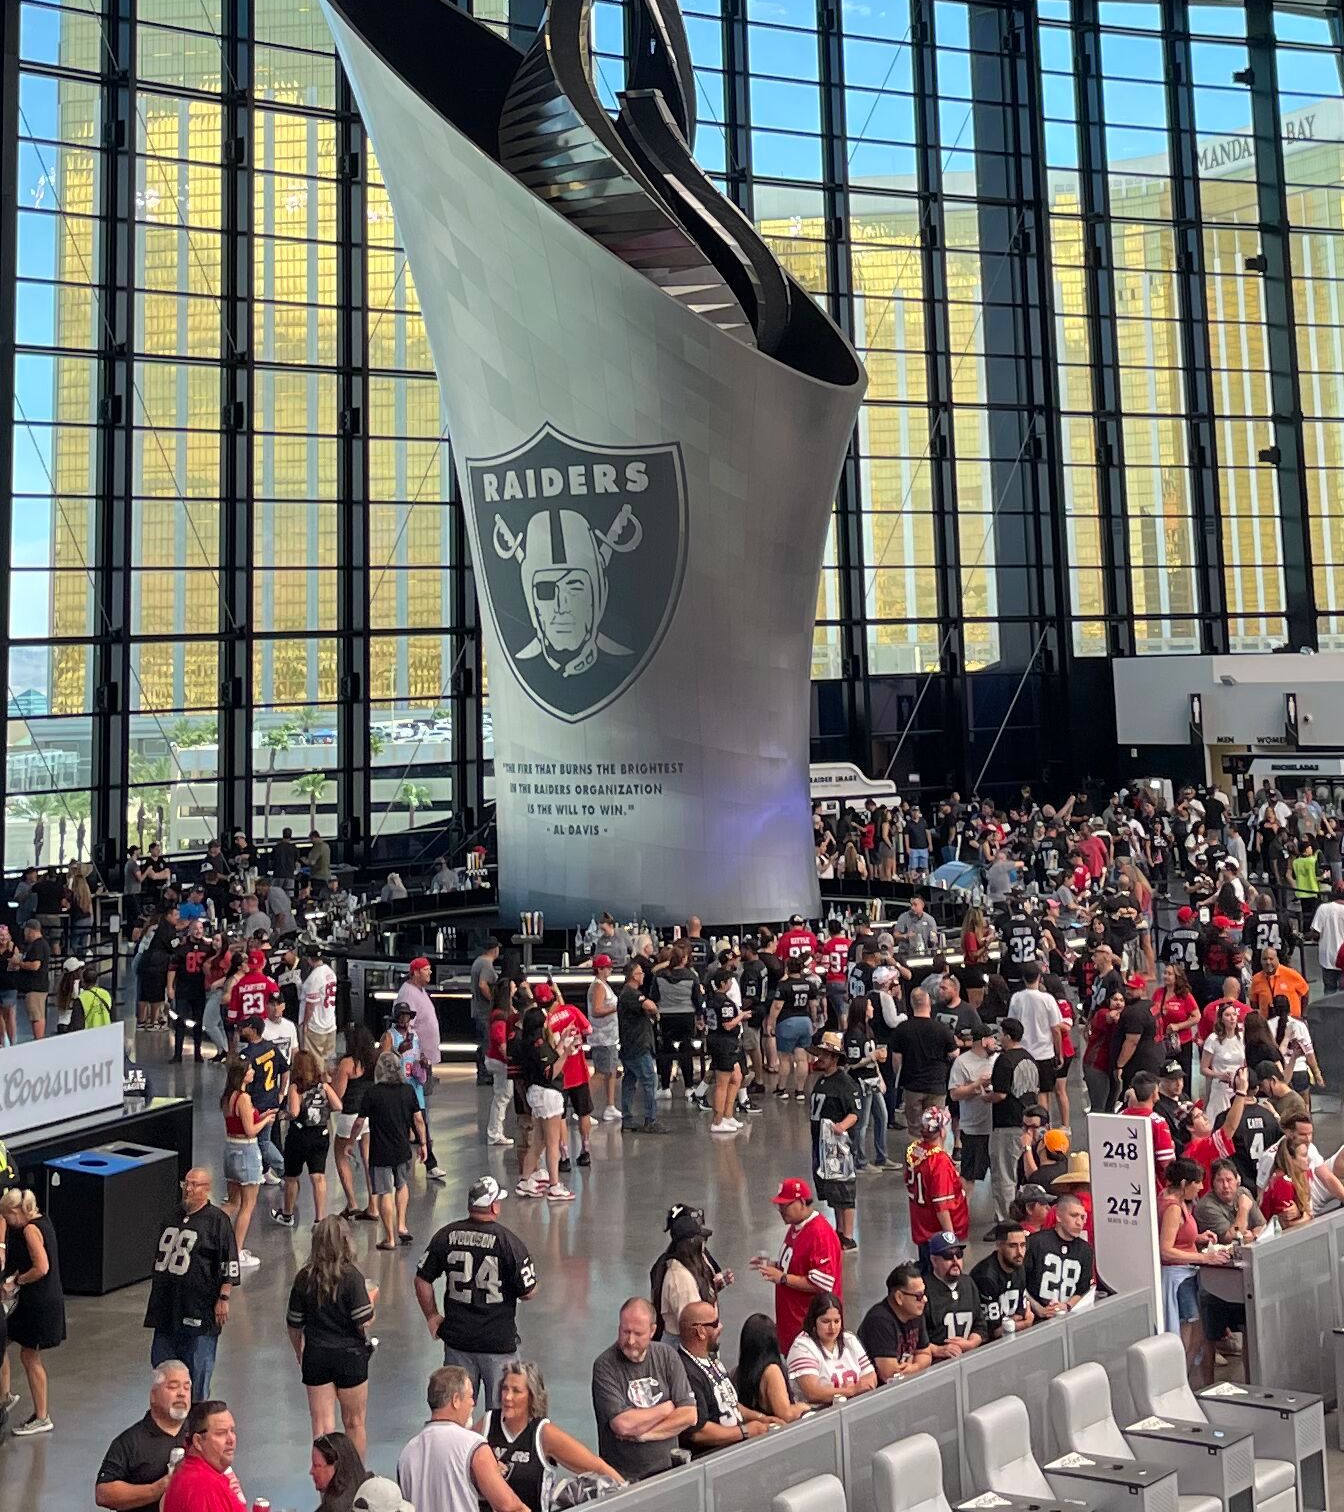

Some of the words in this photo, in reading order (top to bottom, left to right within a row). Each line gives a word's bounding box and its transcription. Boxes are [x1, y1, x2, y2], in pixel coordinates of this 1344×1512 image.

[1286, 114, 1316, 145] BAY
[482, 461, 650, 502] RAIDERS
[535, 763, 556, 775] THAT
[559, 763, 592, 775] BURNS
[596, 763, 616, 775] THE
[620, 762, 684, 774] BRIGHTEST
[534, 783, 571, 795] RAIDERS
[574, 783, 663, 795] ORGANIZATION
[527, 803, 535, 814] IS
[537, 804, 552, 815] THE
[556, 804, 578, 815] WILL
[581, 804, 595, 815] TO
[553, 824, 565, 835] AL
[568, 824, 599, 835] DAVIS
[1010, 936, 1036, 963] 32
[1257, 923, 1281, 950] 24
[243, 992, 265, 1015] 23
[3, 1067, 62, 1111] Coors
[62, 1059, 114, 1095] LIGHT
[1103, 1141, 1138, 1160] 248
[1250, 1133, 1265, 1159] 4
[1107, 1196, 1142, 1216] 247
[154, 1226, 198, 1276] 98
[448, 1230, 496, 1249] WOODSON
[446, 1250, 503, 1304] 24
[1039, 1253, 1082, 1301] 28
